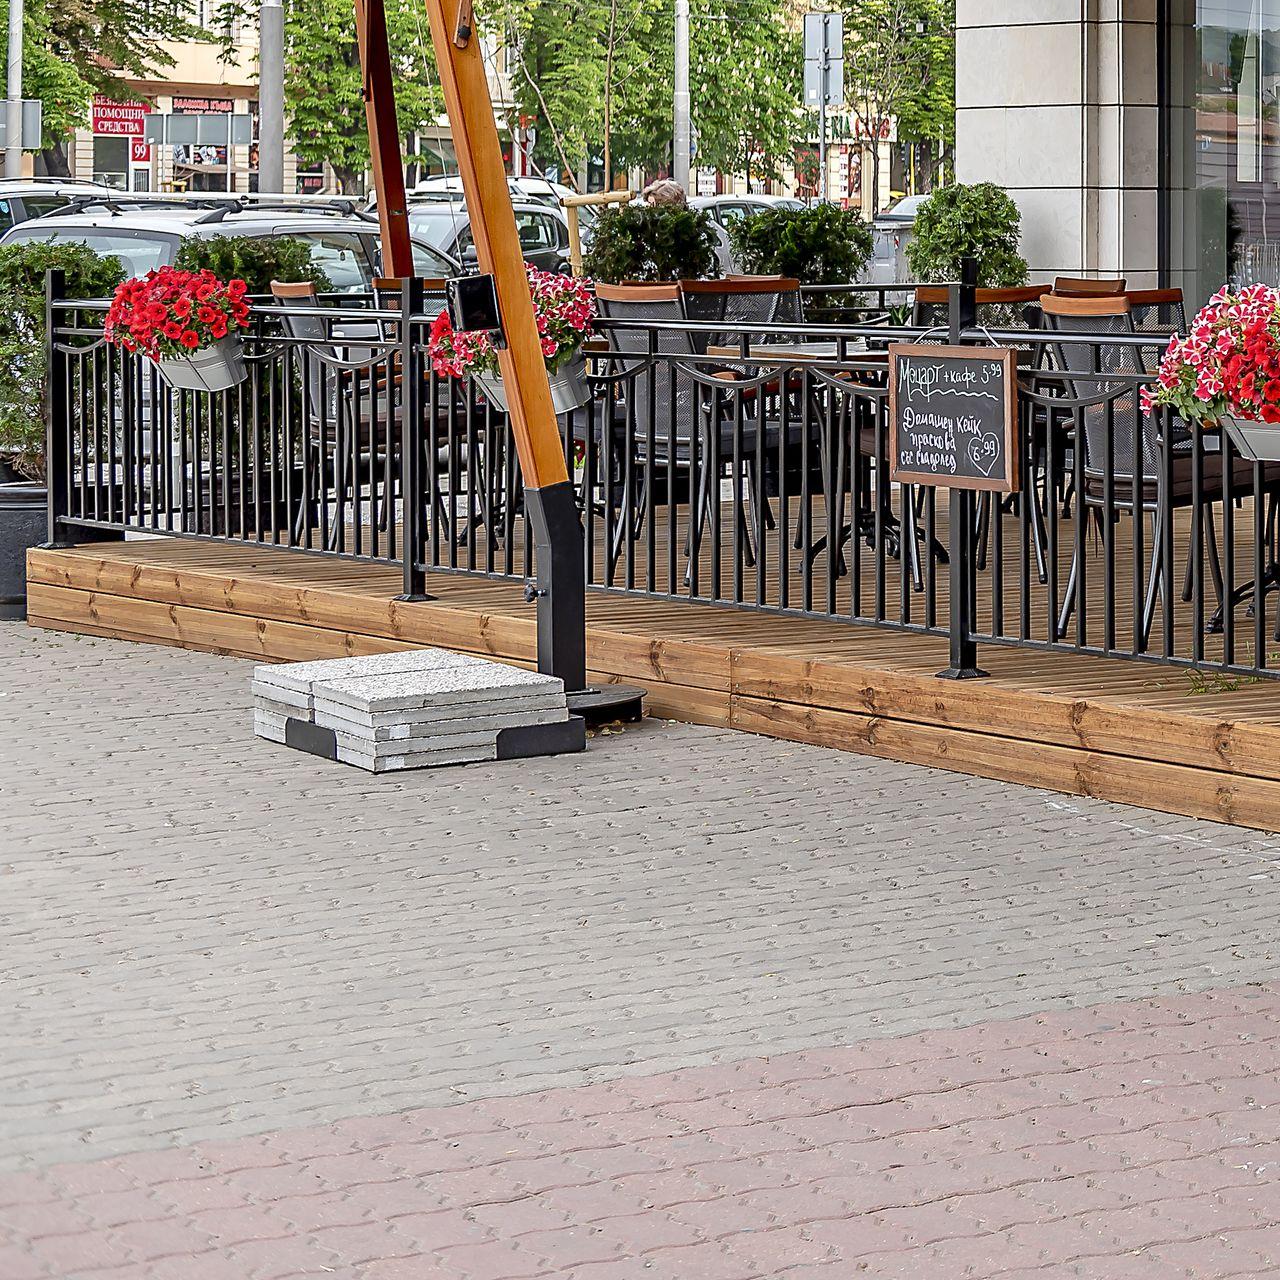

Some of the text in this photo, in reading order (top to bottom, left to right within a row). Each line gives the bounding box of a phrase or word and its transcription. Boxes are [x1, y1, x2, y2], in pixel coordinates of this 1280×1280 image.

[94, 107, 144, 120] ПОМОЩНИ
[98, 121, 140, 133] СРЕДСТВА
[134, 144, 147, 159] 99
